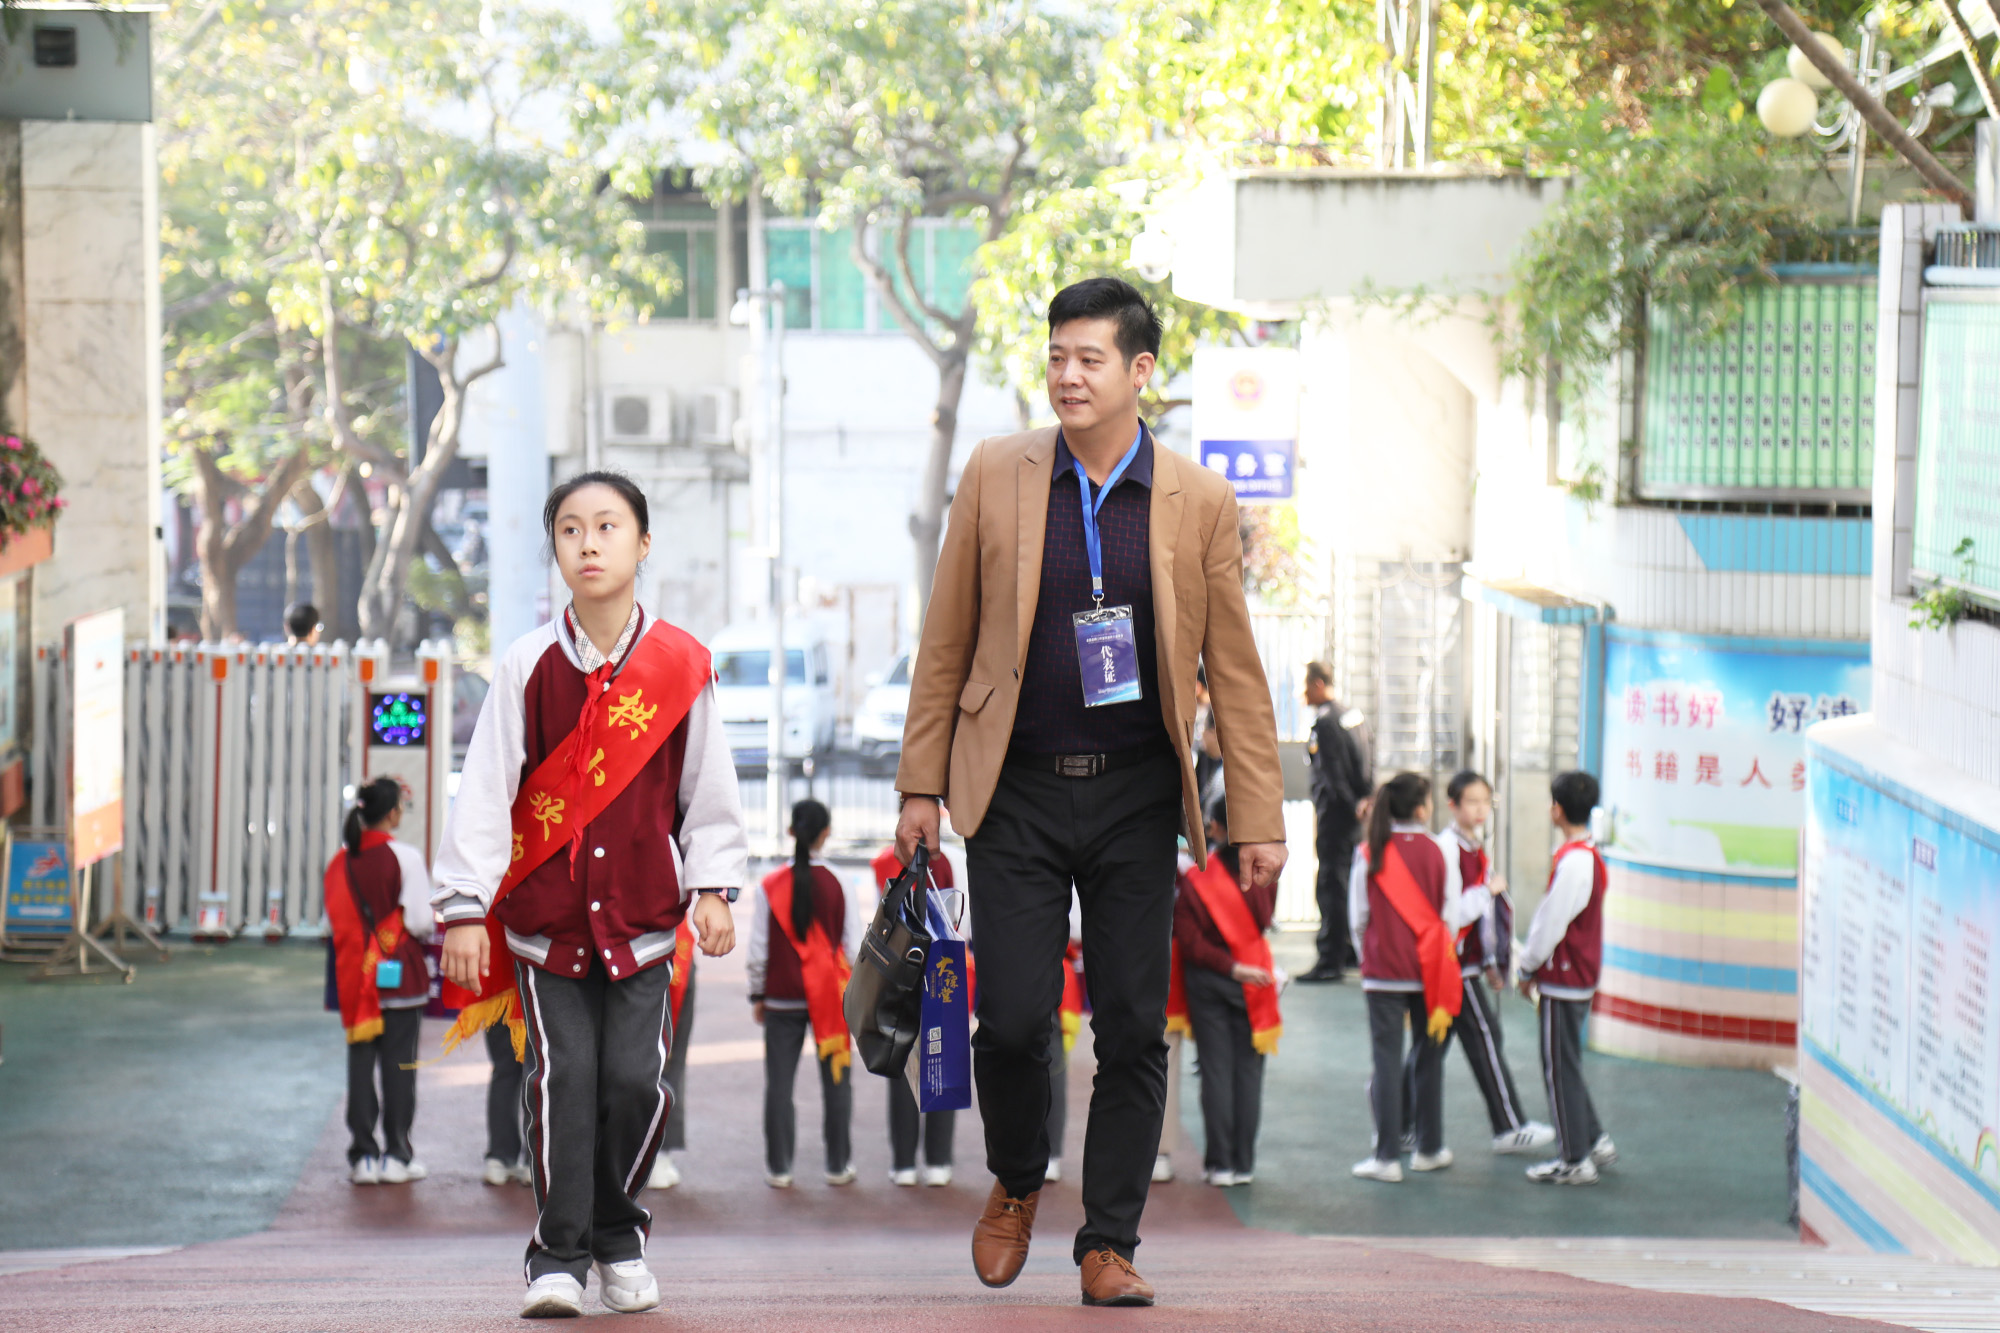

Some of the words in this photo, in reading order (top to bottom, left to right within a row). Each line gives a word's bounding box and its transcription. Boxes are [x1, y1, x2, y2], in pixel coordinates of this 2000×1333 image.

[1101, 645, 1117, 684] 代表证
[1625, 687, 1722, 730] 读书好
